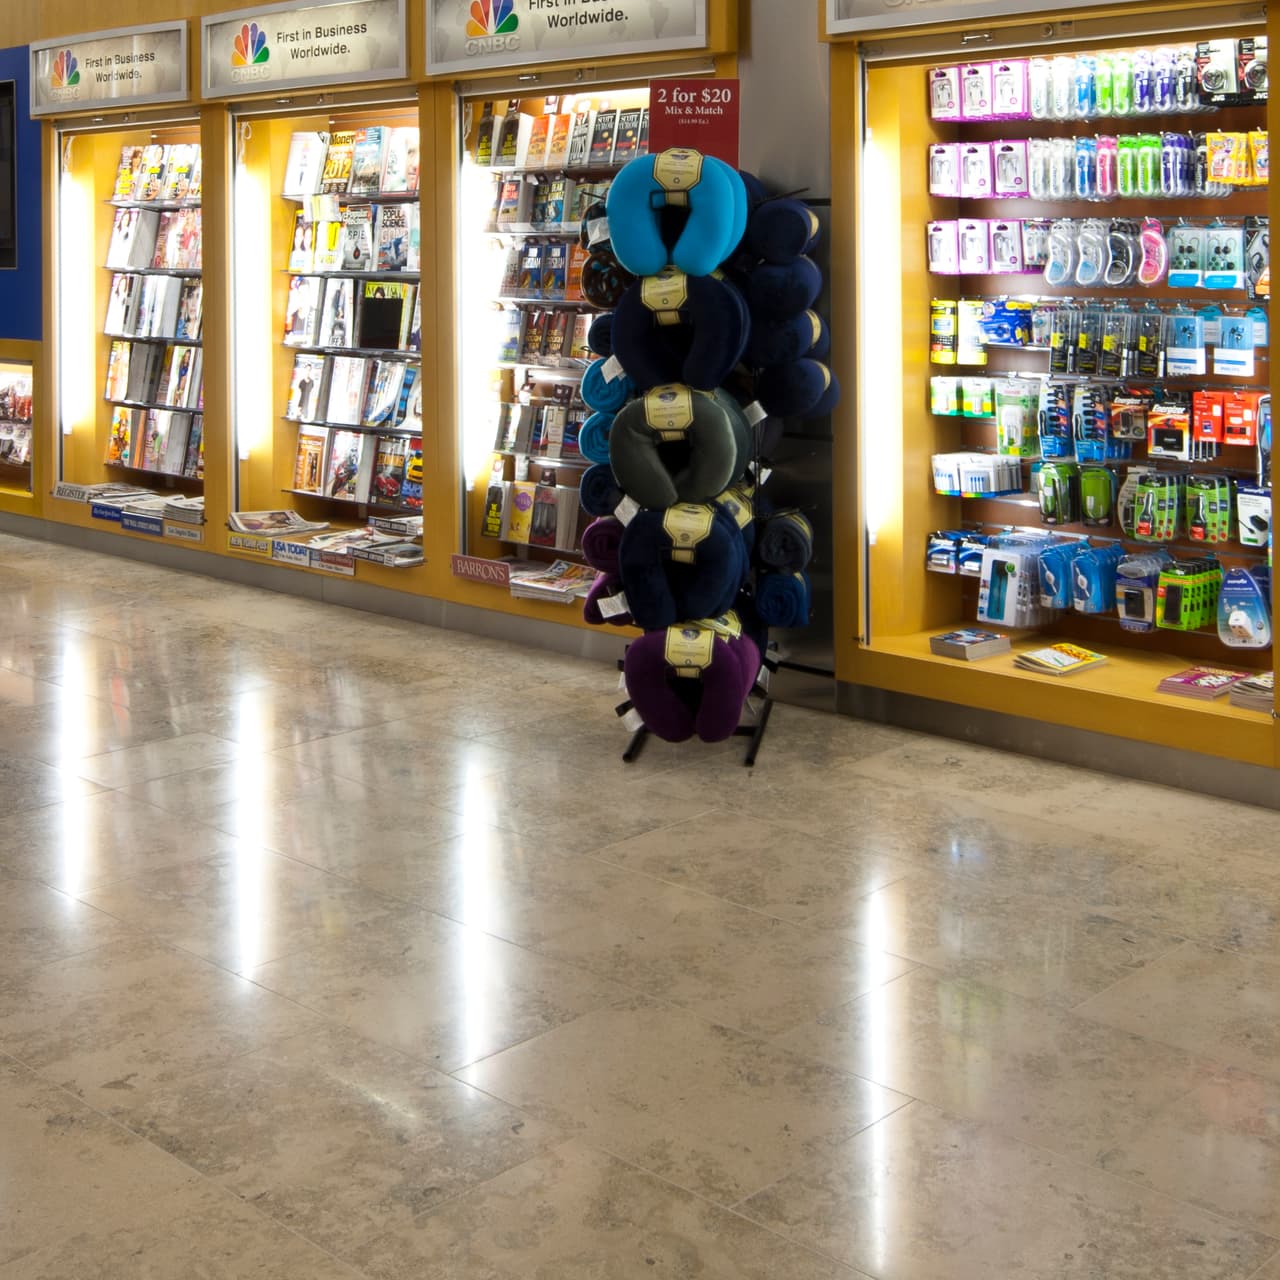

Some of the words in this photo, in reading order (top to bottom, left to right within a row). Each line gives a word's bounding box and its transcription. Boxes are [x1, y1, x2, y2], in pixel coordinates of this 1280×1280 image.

[547, 8, 628, 29] Worldwide.
[277, 30, 299, 44] First
[303, 28, 312, 40] in
[315, 22, 367, 38] Business
[290, 43, 351, 60] Worldwide.
[464, 35, 520, 56] CNBC
[85, 57, 103, 69] First
[105, 55, 112, 66] in
[115, 51, 155, 64] Business
[95, 68, 142, 83] Worldwide.
[657, 89, 667, 103] 2
[672, 87, 697, 103] for
[701, 88, 732, 104] $20
[665, 106, 682, 115] Mix
[685, 107, 693, 115] &
[695, 106, 723, 115] Match
[330, 134, 356, 145] Money
[324, 159, 352, 178] 2012
[367, 286, 402, 298] MIM
[1153, 404, 1186, 414] Energizer
[272, 540, 286, 553] USA
[287, 542, 308, 556] TODAY
